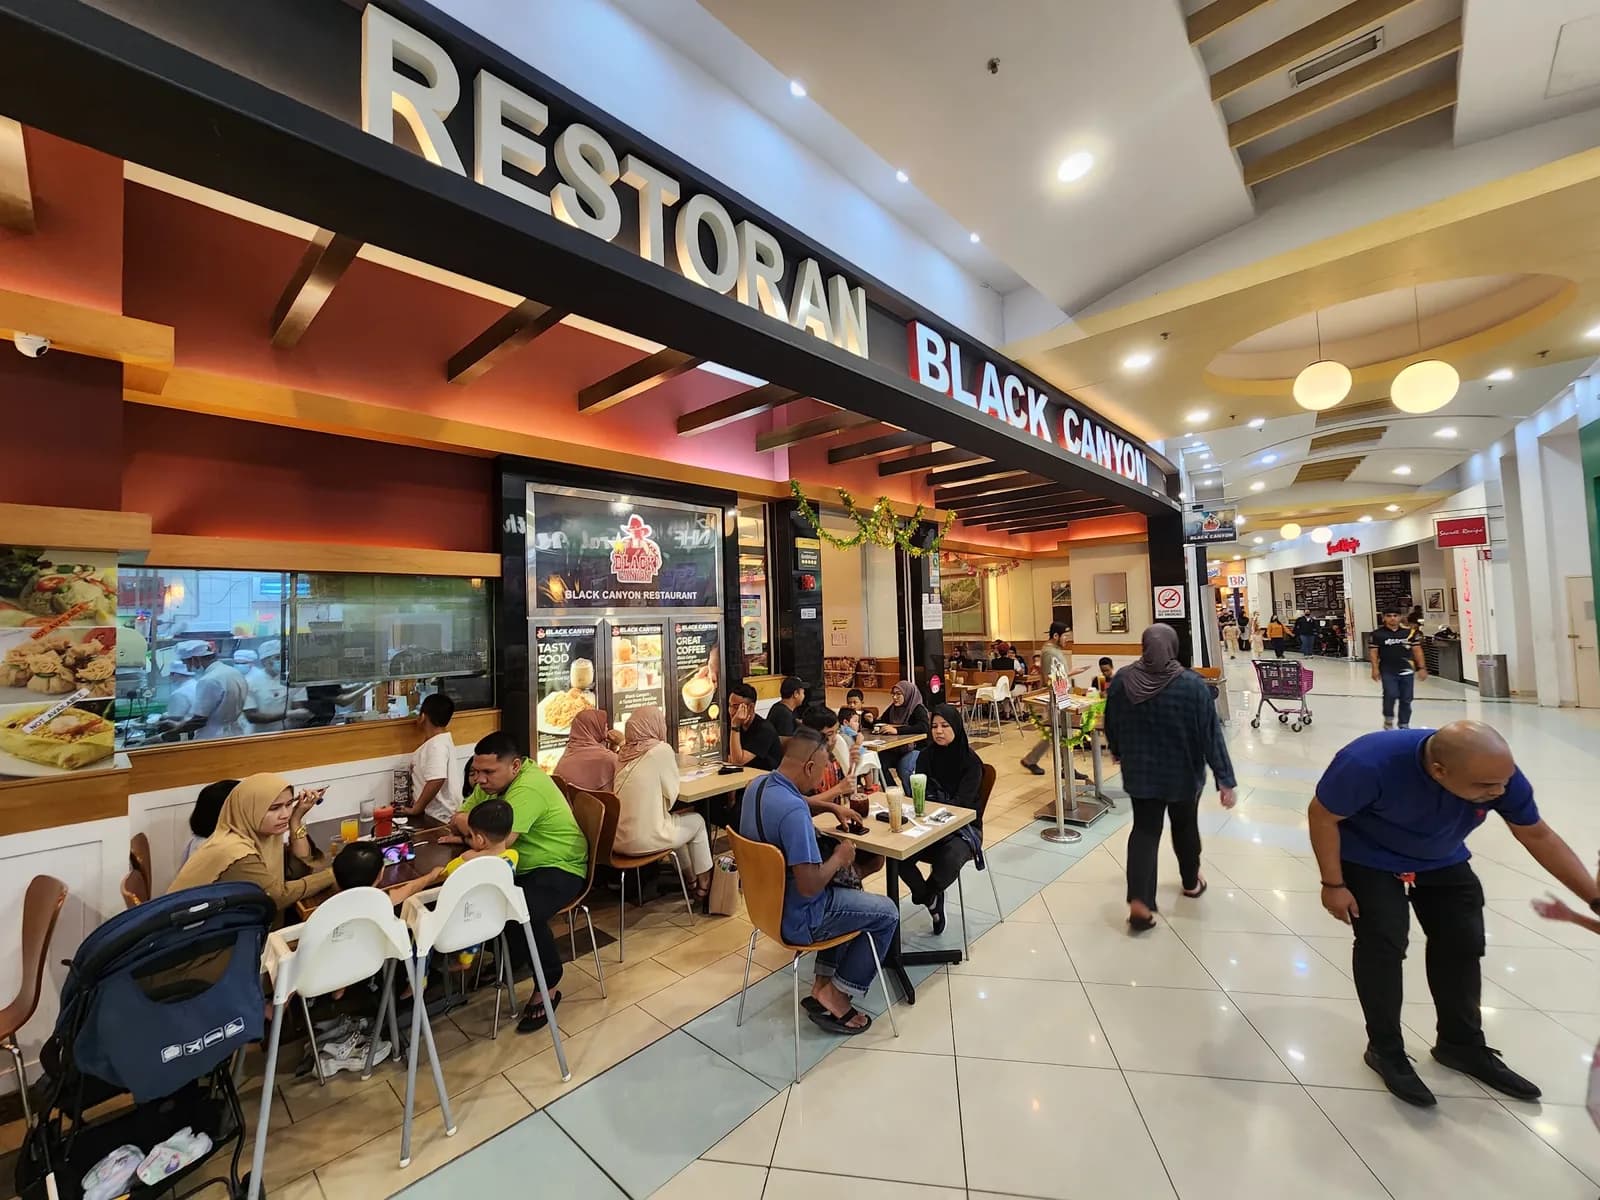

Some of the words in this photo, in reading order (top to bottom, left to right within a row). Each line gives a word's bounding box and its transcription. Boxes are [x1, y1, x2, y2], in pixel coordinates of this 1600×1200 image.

[361, 3, 869, 361] RESTORAN
[908, 320, 1052, 443] BLACK
[1058, 407, 1148, 486] CANYON
[614, 554, 657, 571] BLACK
[565, 590, 600, 600] BLACK
[602, 591, 641, 600] CANYON
[643, 591, 697, 600] RESTAURANT
[676, 636, 702, 645] GREAT
[538, 643, 571, 653] TASTY
[676, 645, 706, 655] COFFEE
[538, 653, 570, 665] FOOD
[29, 718, 45, 730] NOT
